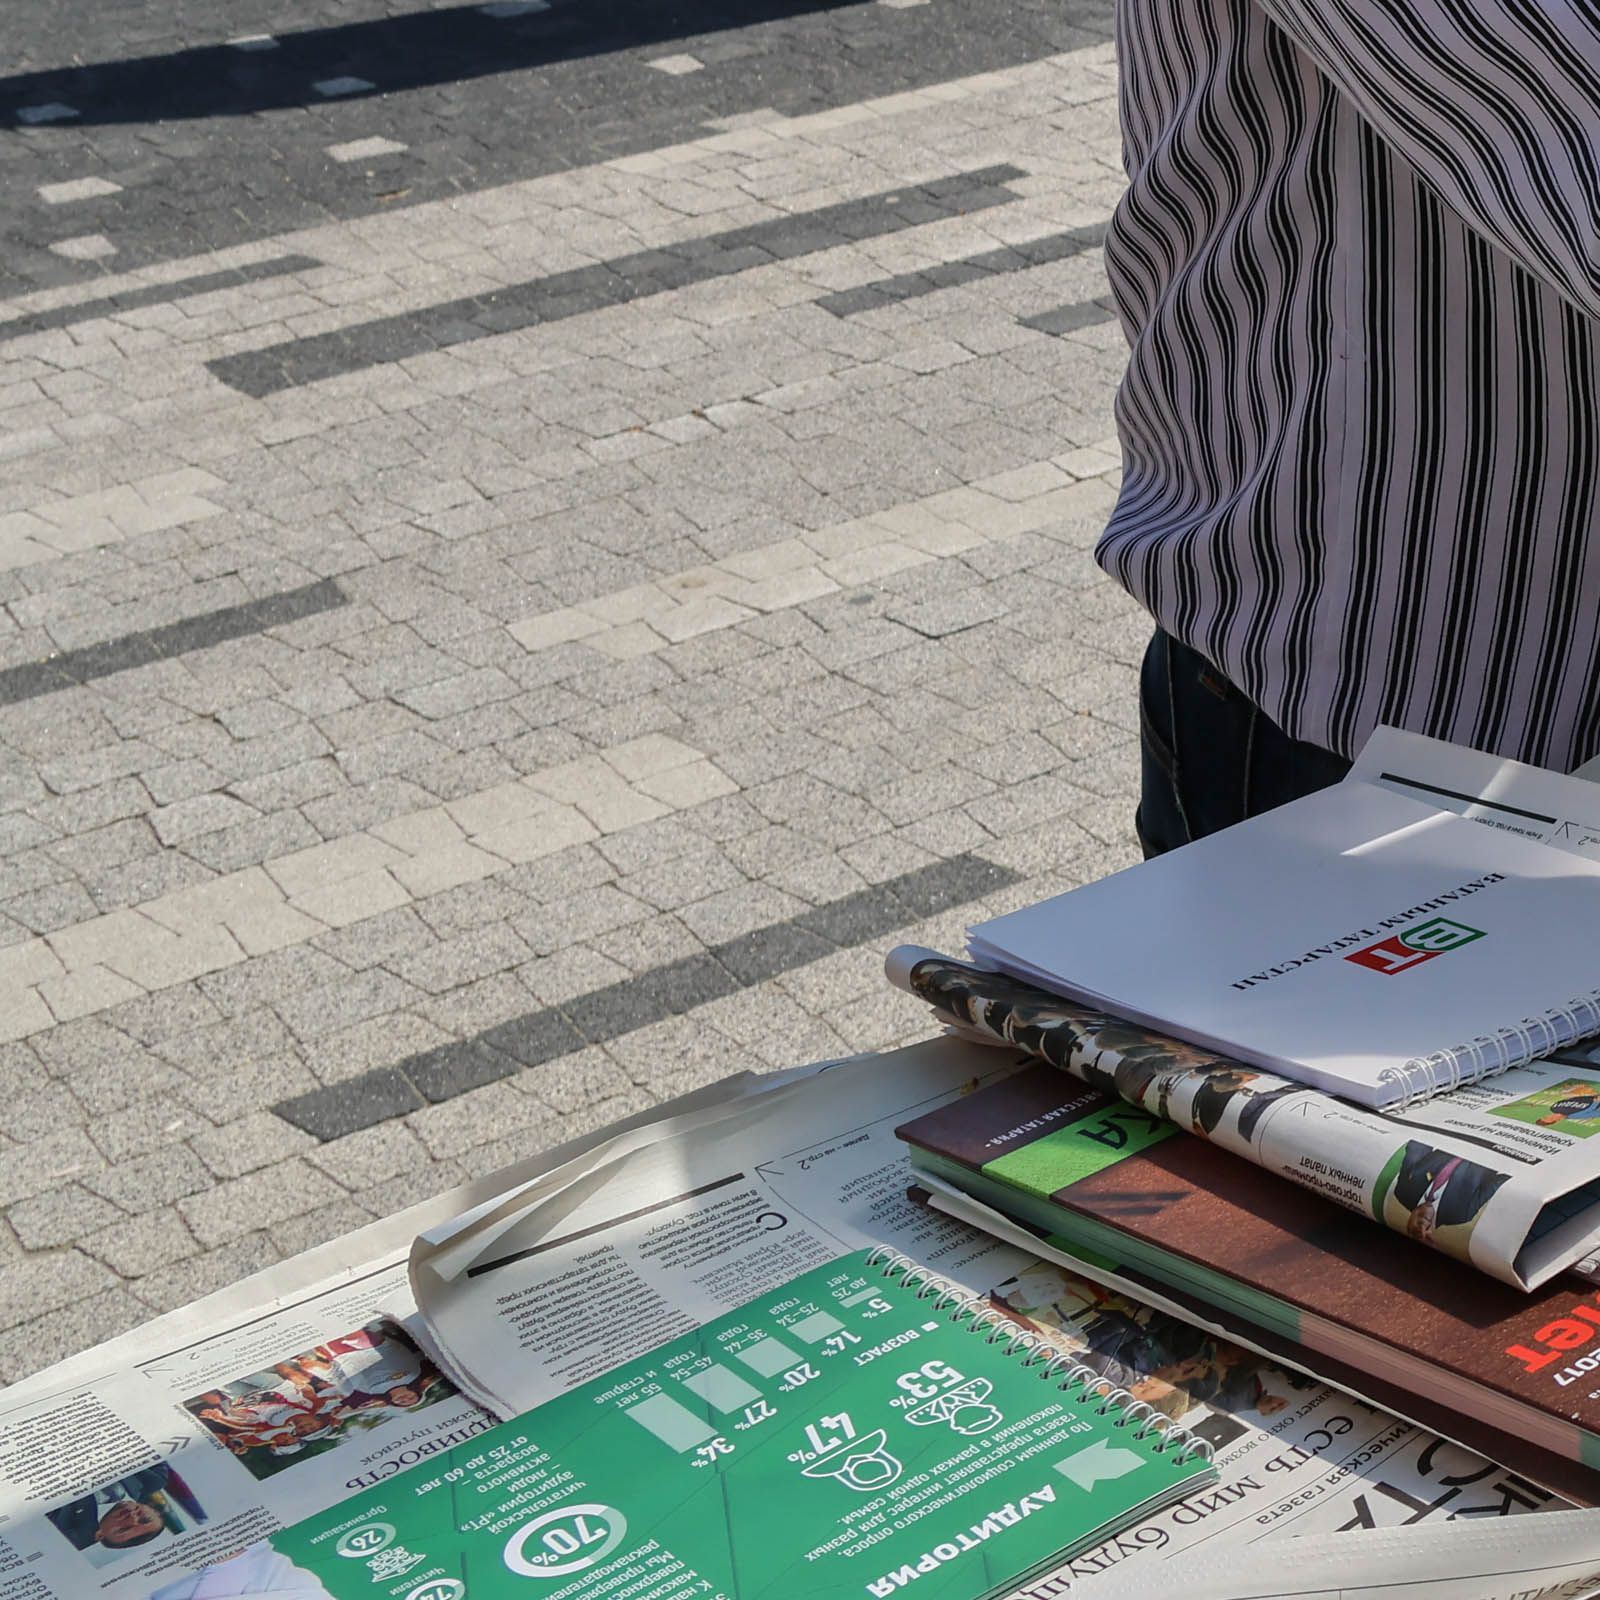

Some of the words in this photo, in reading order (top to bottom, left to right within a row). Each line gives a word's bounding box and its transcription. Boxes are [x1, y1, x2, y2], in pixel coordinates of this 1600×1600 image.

[1376, 871, 1506, 929] ВАТАНЫМ
[1228, 925, 1381, 991] ТАТАРСТАН
[987, 1118, 1046, 1145] ТАТАРИЯ
[1491, 1119, 1579, 1147] кредитования
[1494, 1129, 1564, 1154] Изменения
[1299, 1155, 1327, 1174] палат
[1328, 1165, 1364, 1189] ленных
[820, 1272, 853, 1288] лет
[827, 1286, 854, 1299] 25
[844, 1276, 870, 1289] до
[765, 1296, 803, 1316] года
[772, 1302, 823, 1328] 25–34
[849, 1296, 896, 1319] 5%
[713, 1322, 752, 1343] года
[720, 1327, 769, 1353] 35–44
[809, 1328, 864, 1358] 14%
[848, 1329, 922, 1365] ВОЗРАСТ
[660, 1349, 700, 1370] года
[667, 1355, 718, 1381] 45–54
[588, 1375, 648, 1405] старше
[636, 1382, 665, 1396] 55
[767, 1362, 825, 1393] 20%
[888, 1359, 968, 1412] 53%
[611, 1392, 644, 1409] лет
[722, 1400, 781, 1431] 27%
[786, 1410, 858, 1466] 47%
[989, 1403, 1066, 1444] поколений
[1031, 1411, 1079, 1437] газета
[1067, 1420, 1093, 1435] По
[339, 1413, 500, 1492] ДЛИВОСТЬ
[484, 1445, 514, 1459] 25
[679, 1436, 740, 1468] 34%
[926, 1443, 983, 1475] рамках
[940, 1432, 1037, 1486] представляет
[1012, 1429, 1075, 1463] данным
[1258, 1412, 1363, 1477] есть
[441, 1465, 472, 1480] 60
[461, 1454, 492, 1469] до
[470, 1444, 543, 1480] возраста
[472, 1452, 554, 1493] активного
[409, 1476, 449, 1496] лет
[490, 1469, 577, 1513] аудитории
[502, 1467, 552, 1493] люди
[882, 1472, 933, 1501] одной
[888, 1458, 1021, 1529] социологического
[482, 1479, 589, 1533] читательской
[832, 1496, 888, 1526] семьи.
[883, 1482, 948, 1516] интерес
[1158, 1475, 1269, 1528] мир
[1253, 1483, 1328, 1526] газета
[305, 1504, 390, 1545] Организации
[452, 1509, 500, 1533] «РТ»
[854, 1512, 891, 1532] для
[351, 1531, 383, 1549] 26
[531, 1526, 608, 1568] 70%
[800, 1527, 862, 1562] разных
[834, 1525, 896, 1559] опроса,
[860, 1483, 1066, 1598] АУДИТОРИЯ
[1020, 1523, 1179, 1600] будущ
[385, 1565, 445, 1596] Читатели
